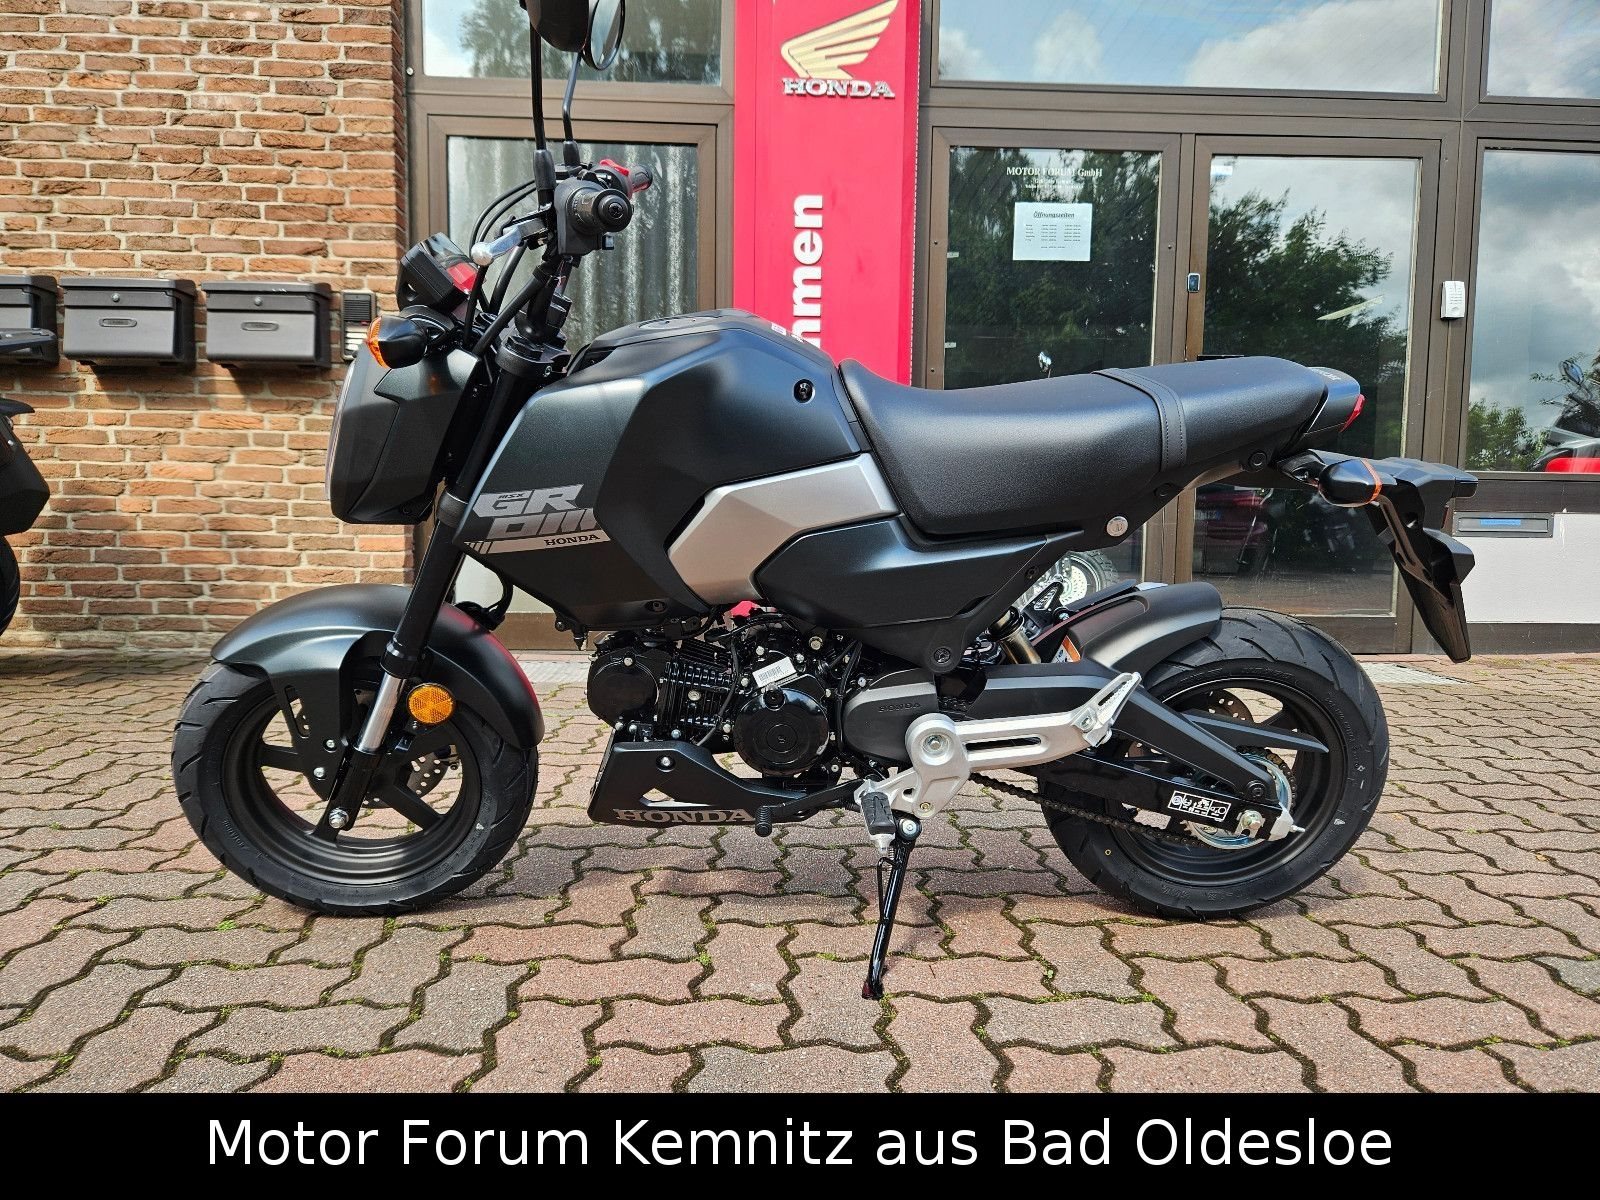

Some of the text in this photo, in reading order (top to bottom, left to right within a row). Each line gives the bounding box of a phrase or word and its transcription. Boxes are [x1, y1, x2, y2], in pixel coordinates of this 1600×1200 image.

[782, 78, 896, 99] HONDA
[1006, 167, 1040, 176] MOTOR
[1077, 168, 1103, 178] GmbH
[544, 534, 600, 546] HONDA
[612, 808, 756, 823] HONDA
